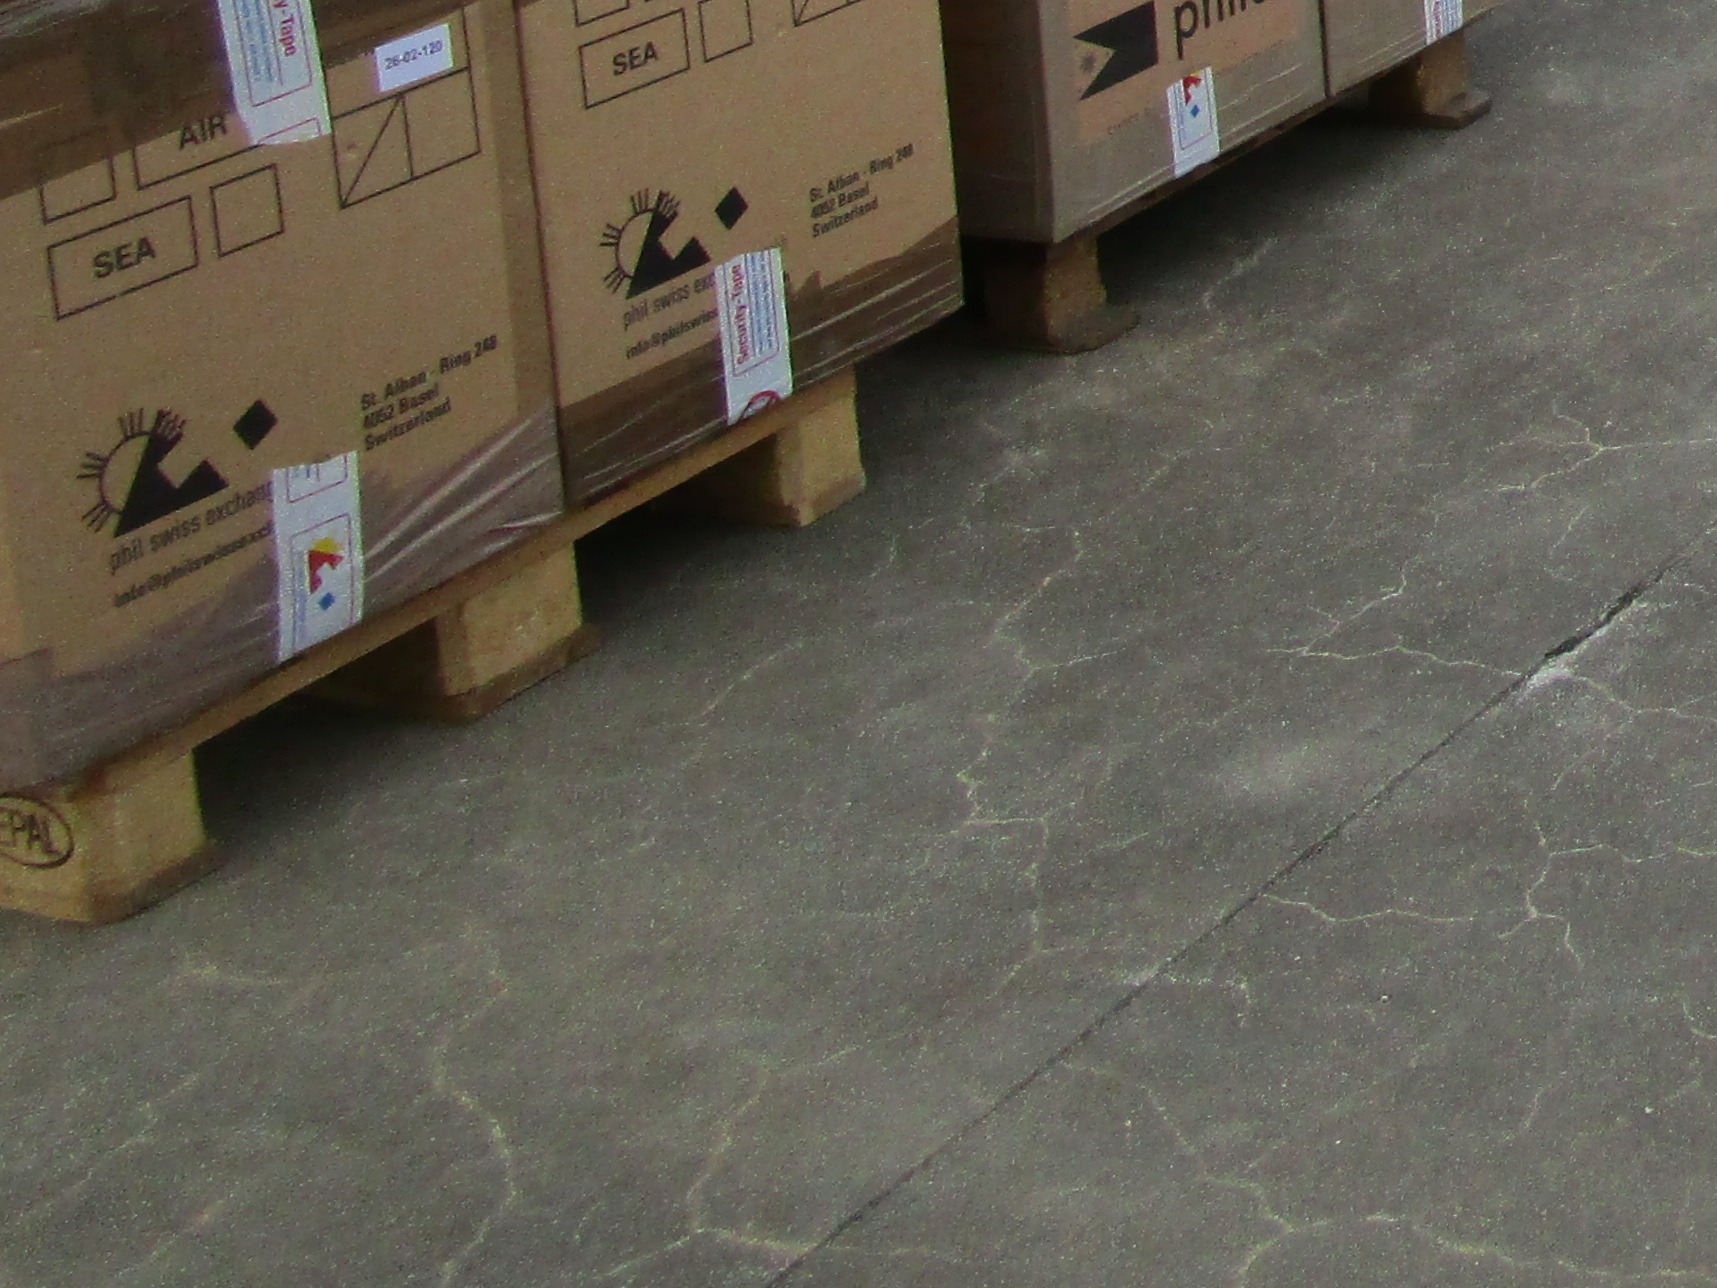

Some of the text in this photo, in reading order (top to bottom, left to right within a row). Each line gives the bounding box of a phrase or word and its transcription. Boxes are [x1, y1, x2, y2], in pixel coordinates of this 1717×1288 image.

[612, 41, 659, 77] SEA
[178, 115, 229, 150] AIR
[93, 236, 156, 279] SEA
